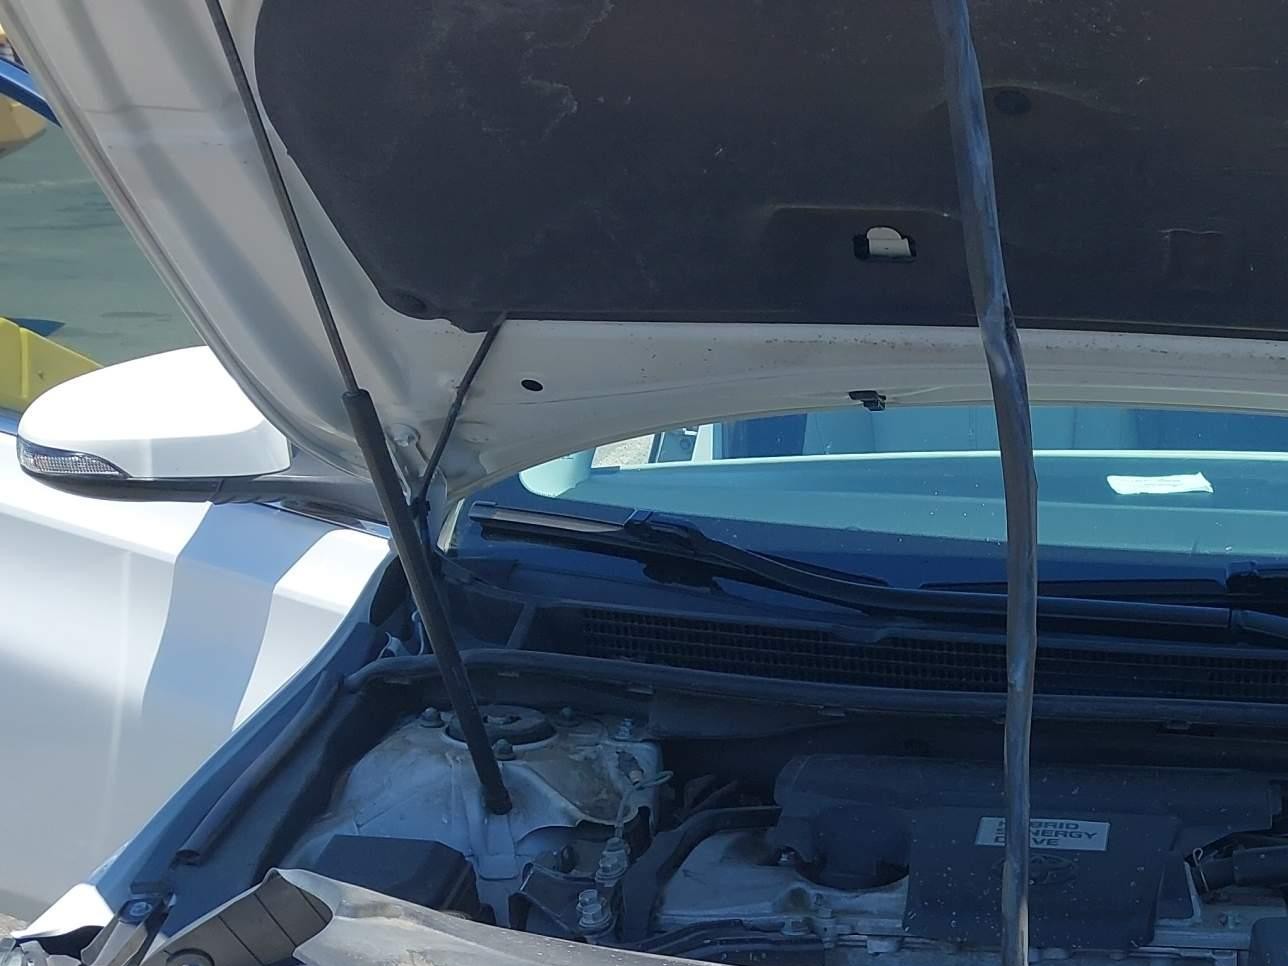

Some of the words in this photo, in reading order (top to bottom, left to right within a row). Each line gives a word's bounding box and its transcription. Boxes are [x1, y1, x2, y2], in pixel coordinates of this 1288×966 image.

[998, 821, 1079, 831] HBRID
[996, 829, 1097, 840] SNERGY
[994, 836, 1060, 846] DVE
